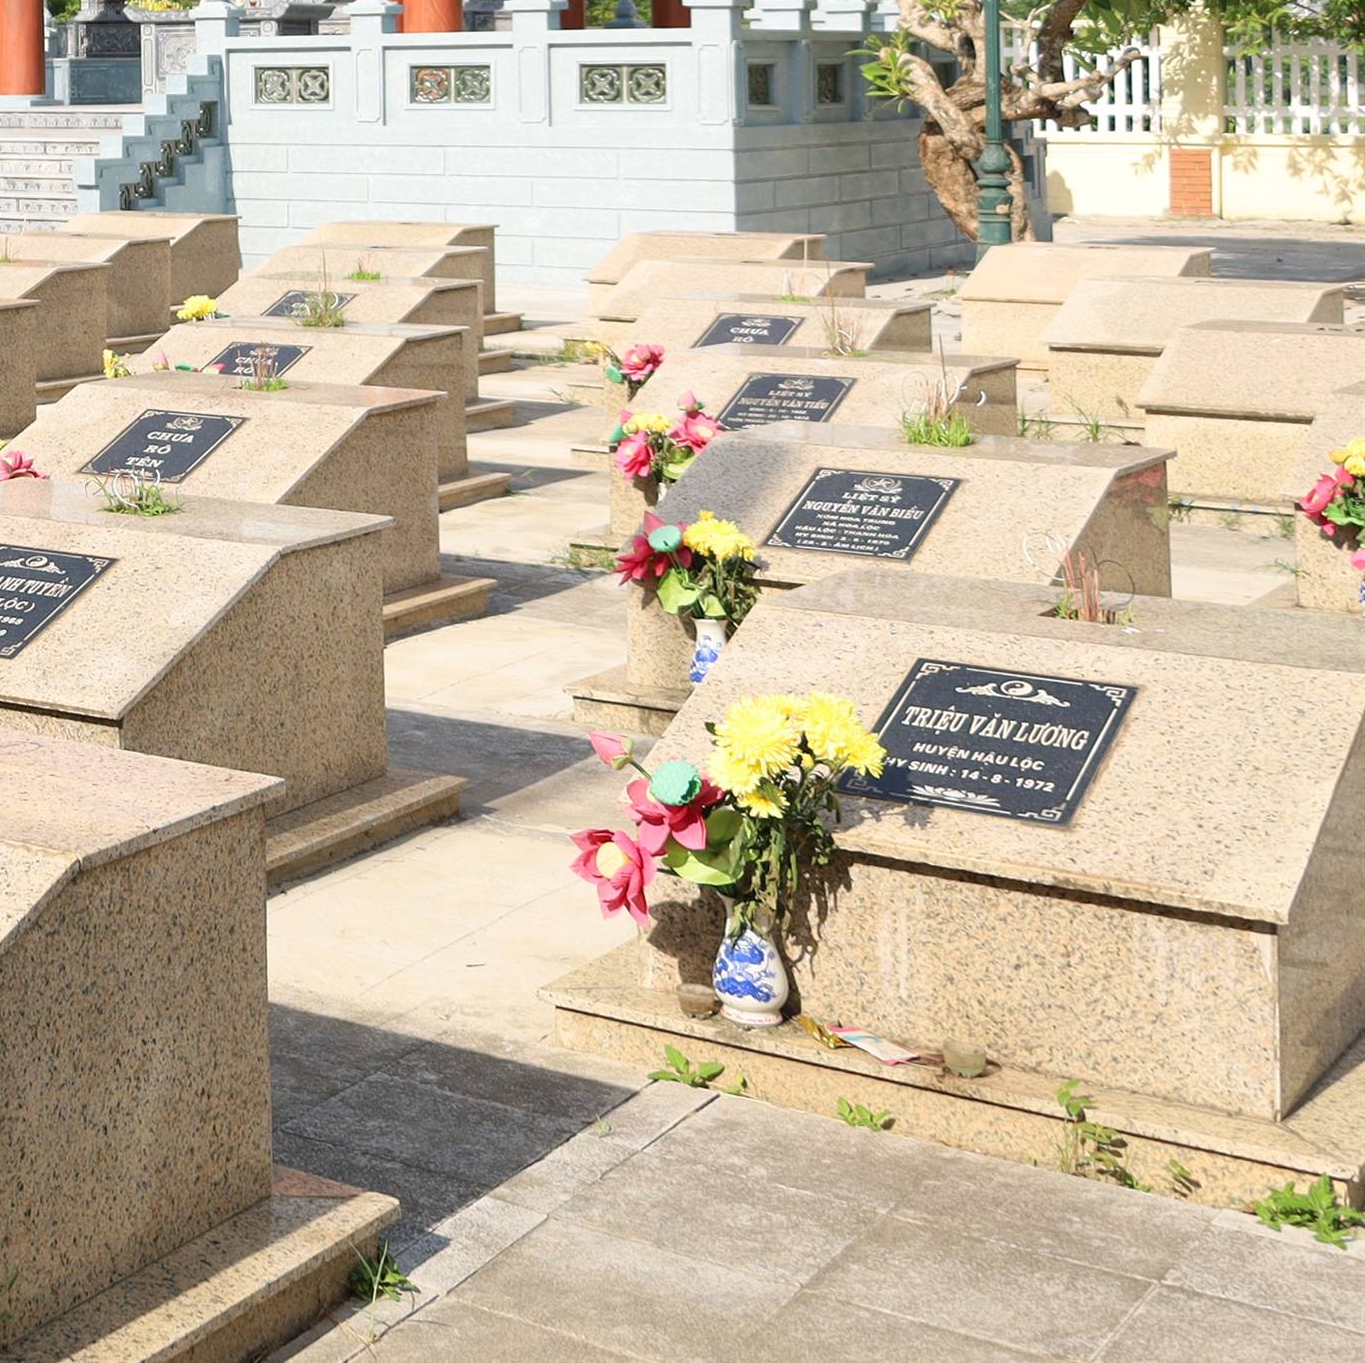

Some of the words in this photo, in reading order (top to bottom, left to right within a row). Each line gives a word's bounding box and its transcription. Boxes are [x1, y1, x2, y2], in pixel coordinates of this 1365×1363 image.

[147, 431, 194, 443] CHƯA
[125, 456, 164, 468] TÊN
[902, 706, 969, 734] TRIỆU
[969, 713, 1017, 739] VĂN
[1013, 722, 1089, 750] LƯƠNG
[913, 742, 970, 759] HUYỆN
[971, 751, 1009, 766] HẬU
[1010, 757, 1045, 771] LỘC
[908, 761, 949, 775] SINH
[1016, 778, 1055, 792] 1972
